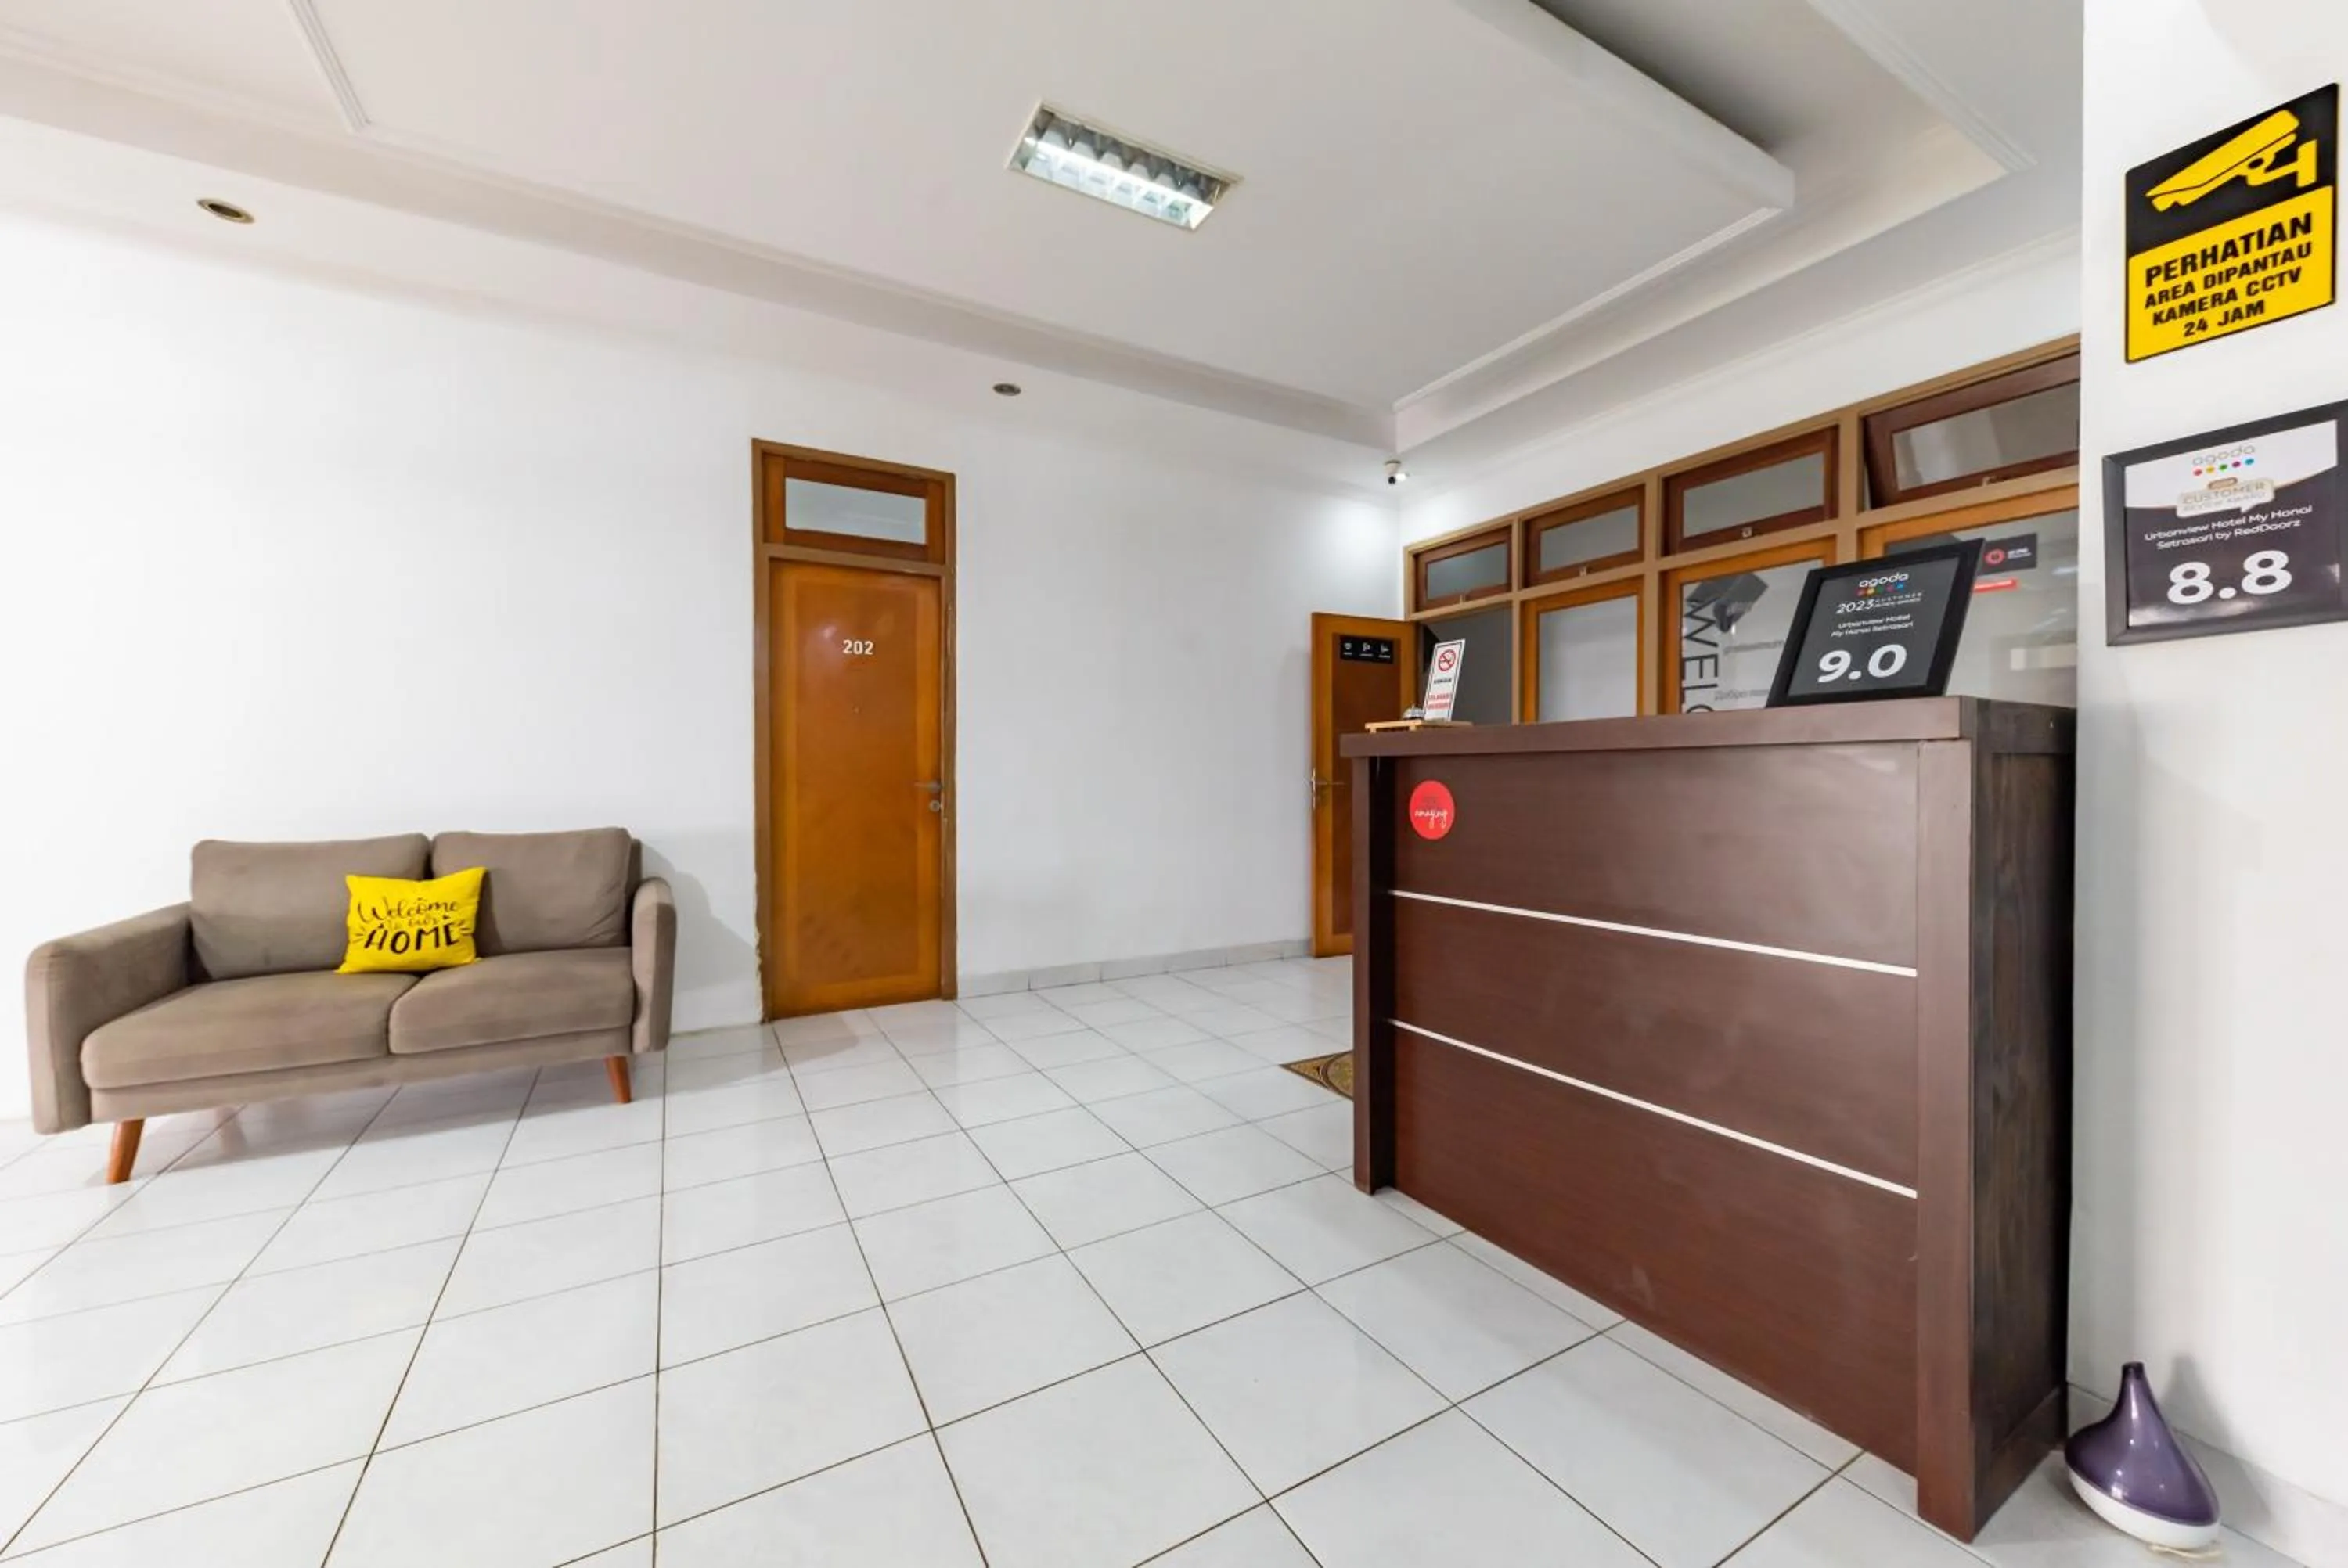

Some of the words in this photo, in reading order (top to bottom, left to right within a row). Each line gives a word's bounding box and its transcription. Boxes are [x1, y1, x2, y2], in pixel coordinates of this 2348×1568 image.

[2145, 212, 2312, 288] PERHATIAN
[2145, 281, 2196, 309] AREA
[2203, 242, 2312, 290] DIPANTAU
[2153, 288, 2238, 325] KAMERA
[2246, 266, 2302, 297] CCTV
[2184, 318, 2209, 336] 24
[2217, 300, 2265, 326] JAM
[2192, 445, 2255, 466] agoda
[2183, 482, 2265, 504] CUSTOMER
[2145, 525, 2209, 541] Urbanview
[2211, 516, 2245, 530] Hotel
[2249, 512, 2268, 527] My
[2156, 533, 2213, 549] Setrasari
[2215, 529, 2231, 541] by
[2234, 520, 2302, 537] RedDoorz
[1859, 572, 1910, 588] agoda
[2167, 550, 2292, 605] 8.8
[1836, 599, 1875, 614] 2023
[842, 639, 874, 655] 202
[1817, 644, 1907, 683] 9.0
[357, 895, 459, 923] Welcome
[363, 922, 460, 955] HOME
